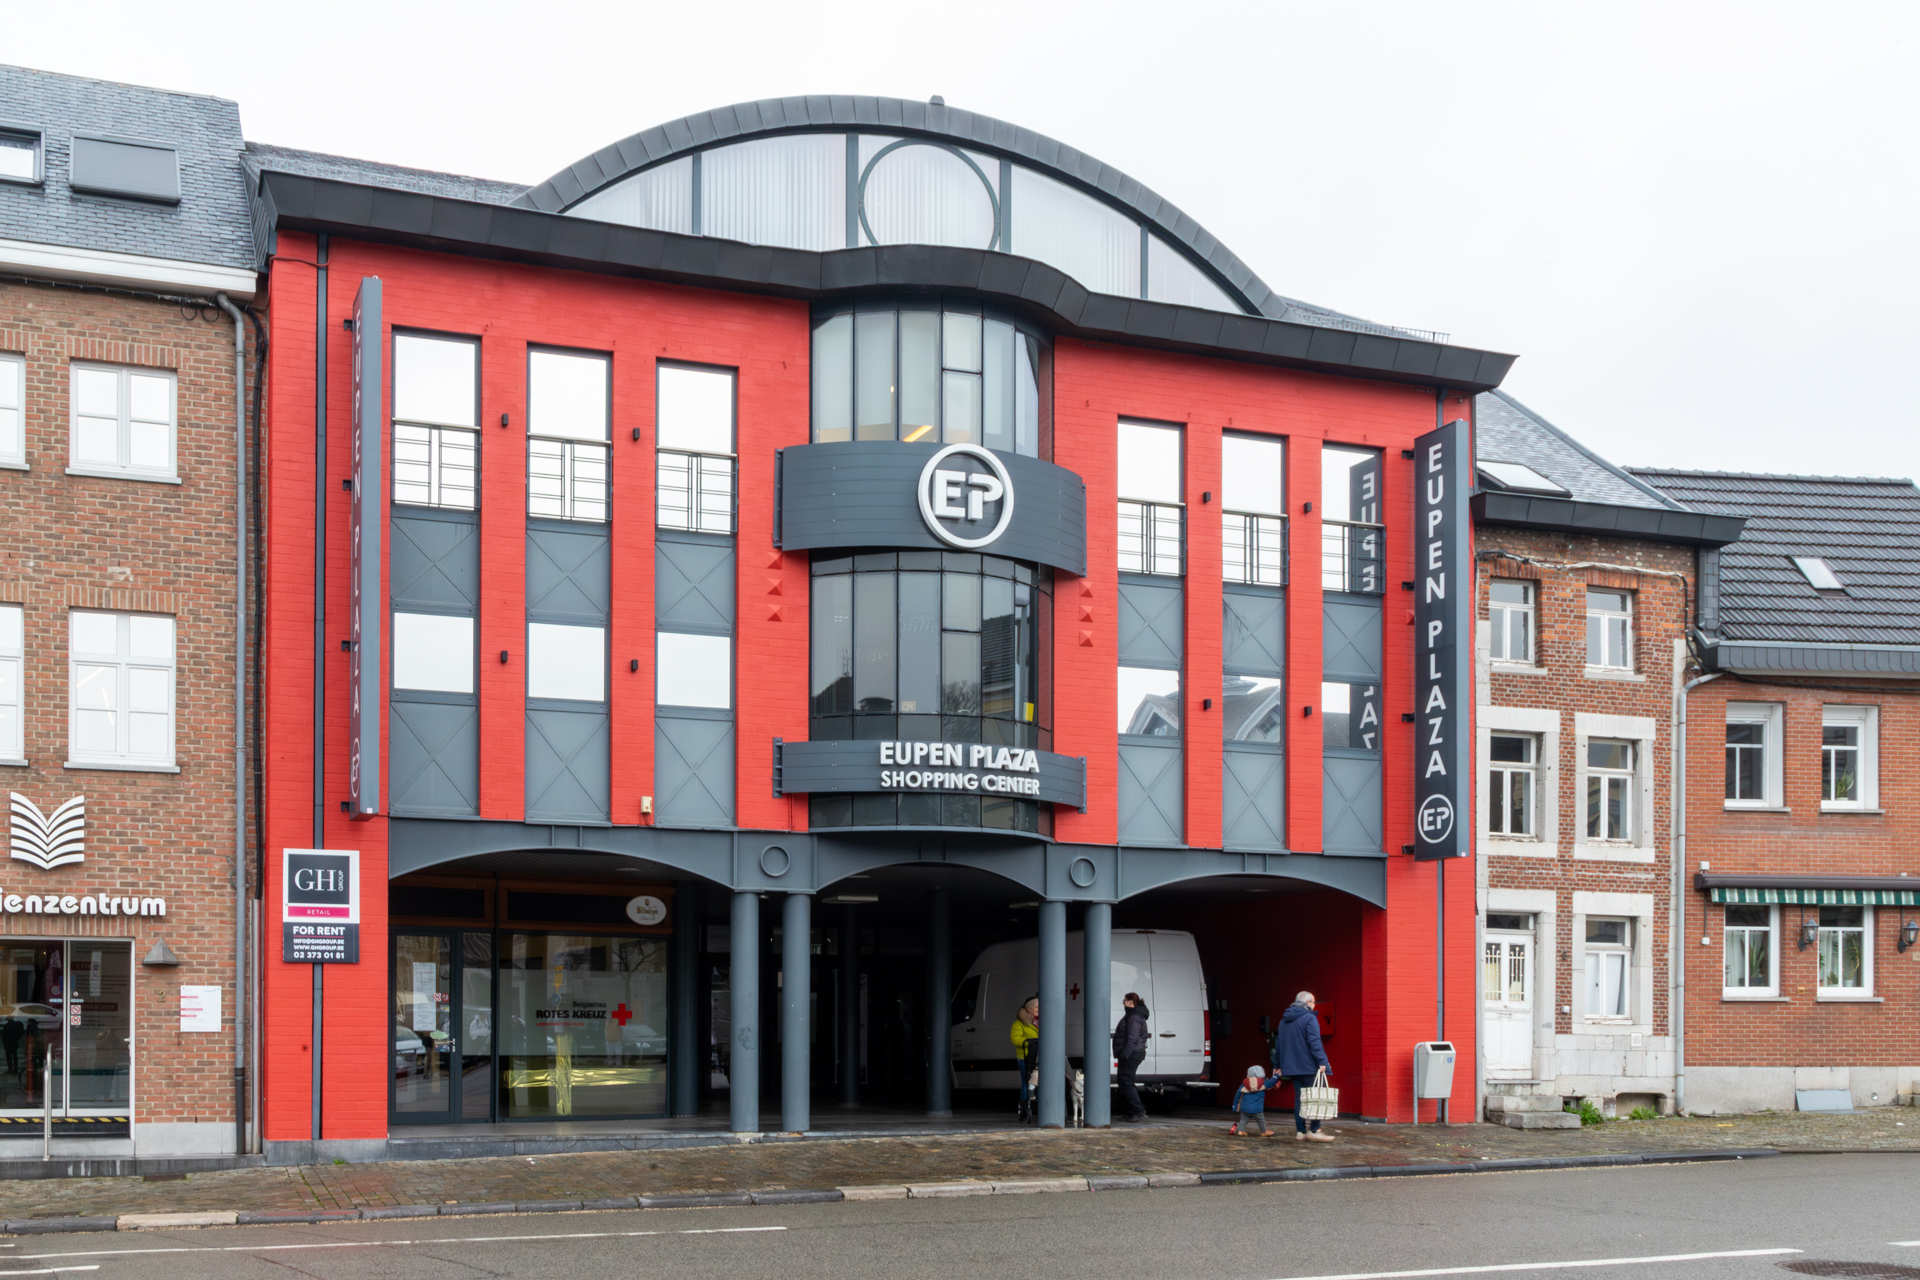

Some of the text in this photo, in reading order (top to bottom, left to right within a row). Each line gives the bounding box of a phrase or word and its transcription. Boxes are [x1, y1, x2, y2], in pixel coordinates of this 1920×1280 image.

[932, 469, 1004, 521] EP
[1424, 442, 1446, 779] EUPEN PLAZA
[880, 742, 1040, 773] EUPEN PLAZA
[880, 769, 1040, 795] SHOPPING CENTER
[1423, 806, 1449, 832] EP
[294, 868, 337, 892] GH
[292, 925, 346, 936] FOR RENT
[293, 951, 305, 959] 02
[306, 951, 322, 959] 373
[536, 1009, 607, 1019] ROTES KREUZ
[572, 1001, 607, 1009] Belgisches
